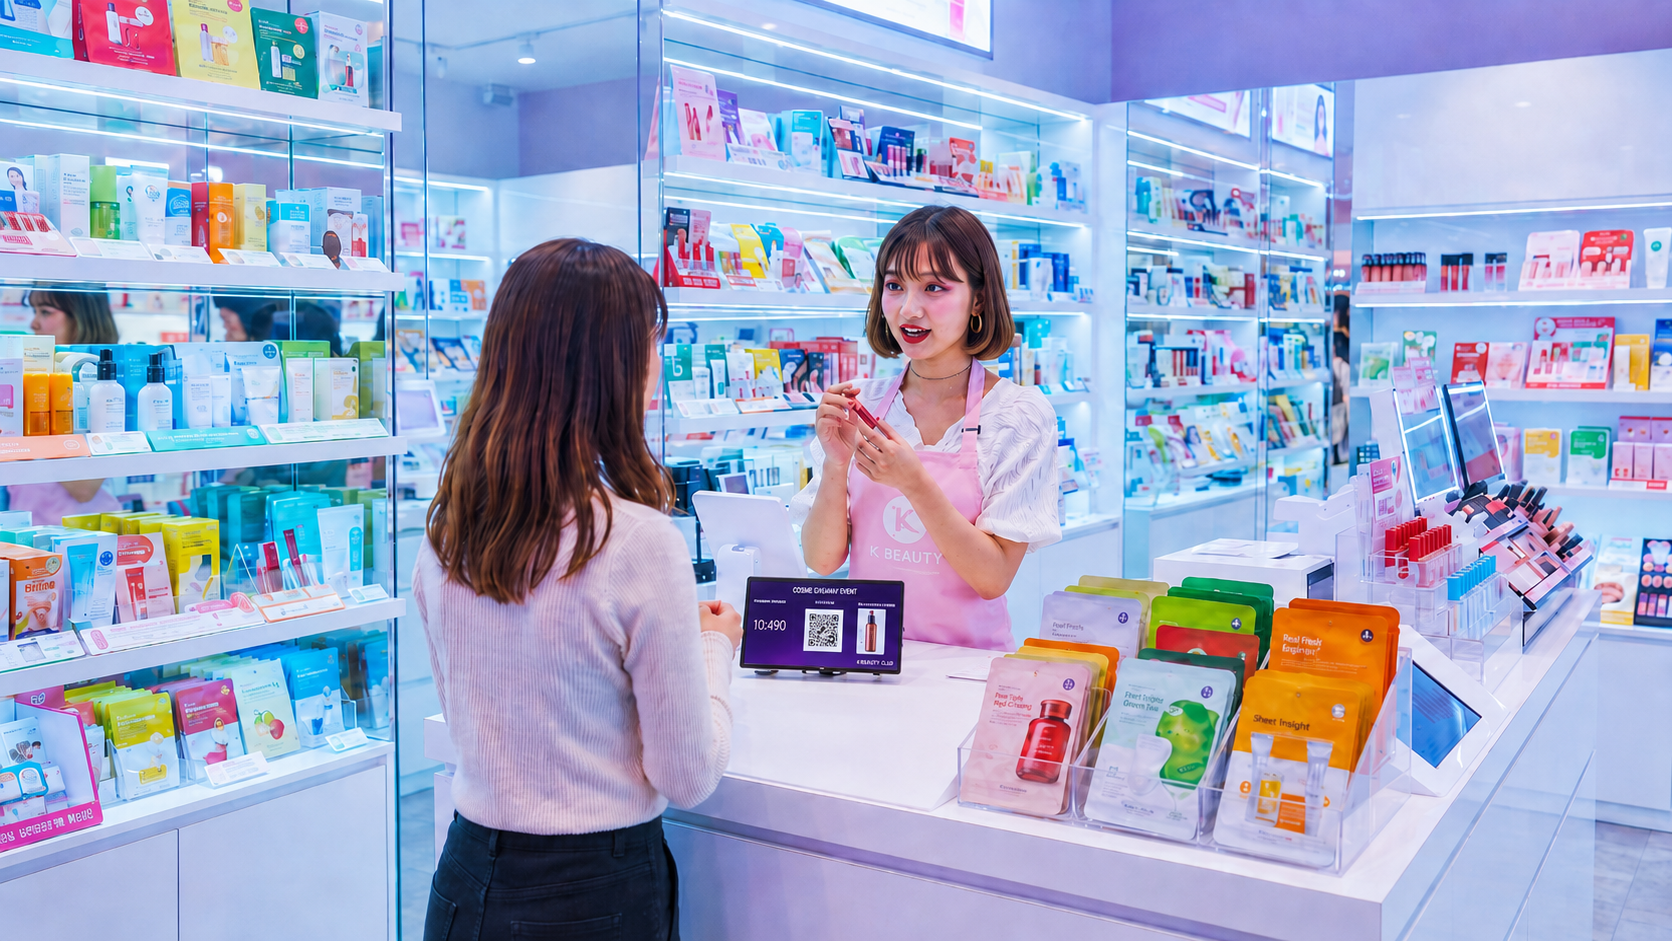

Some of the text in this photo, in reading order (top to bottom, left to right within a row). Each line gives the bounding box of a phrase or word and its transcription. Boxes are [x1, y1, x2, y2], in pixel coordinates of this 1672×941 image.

[870, 545, 942, 565] K BEAUTY
[753, 619, 787, 631] 10:490
[1252, 714, 1311, 731] Sheet Insight
